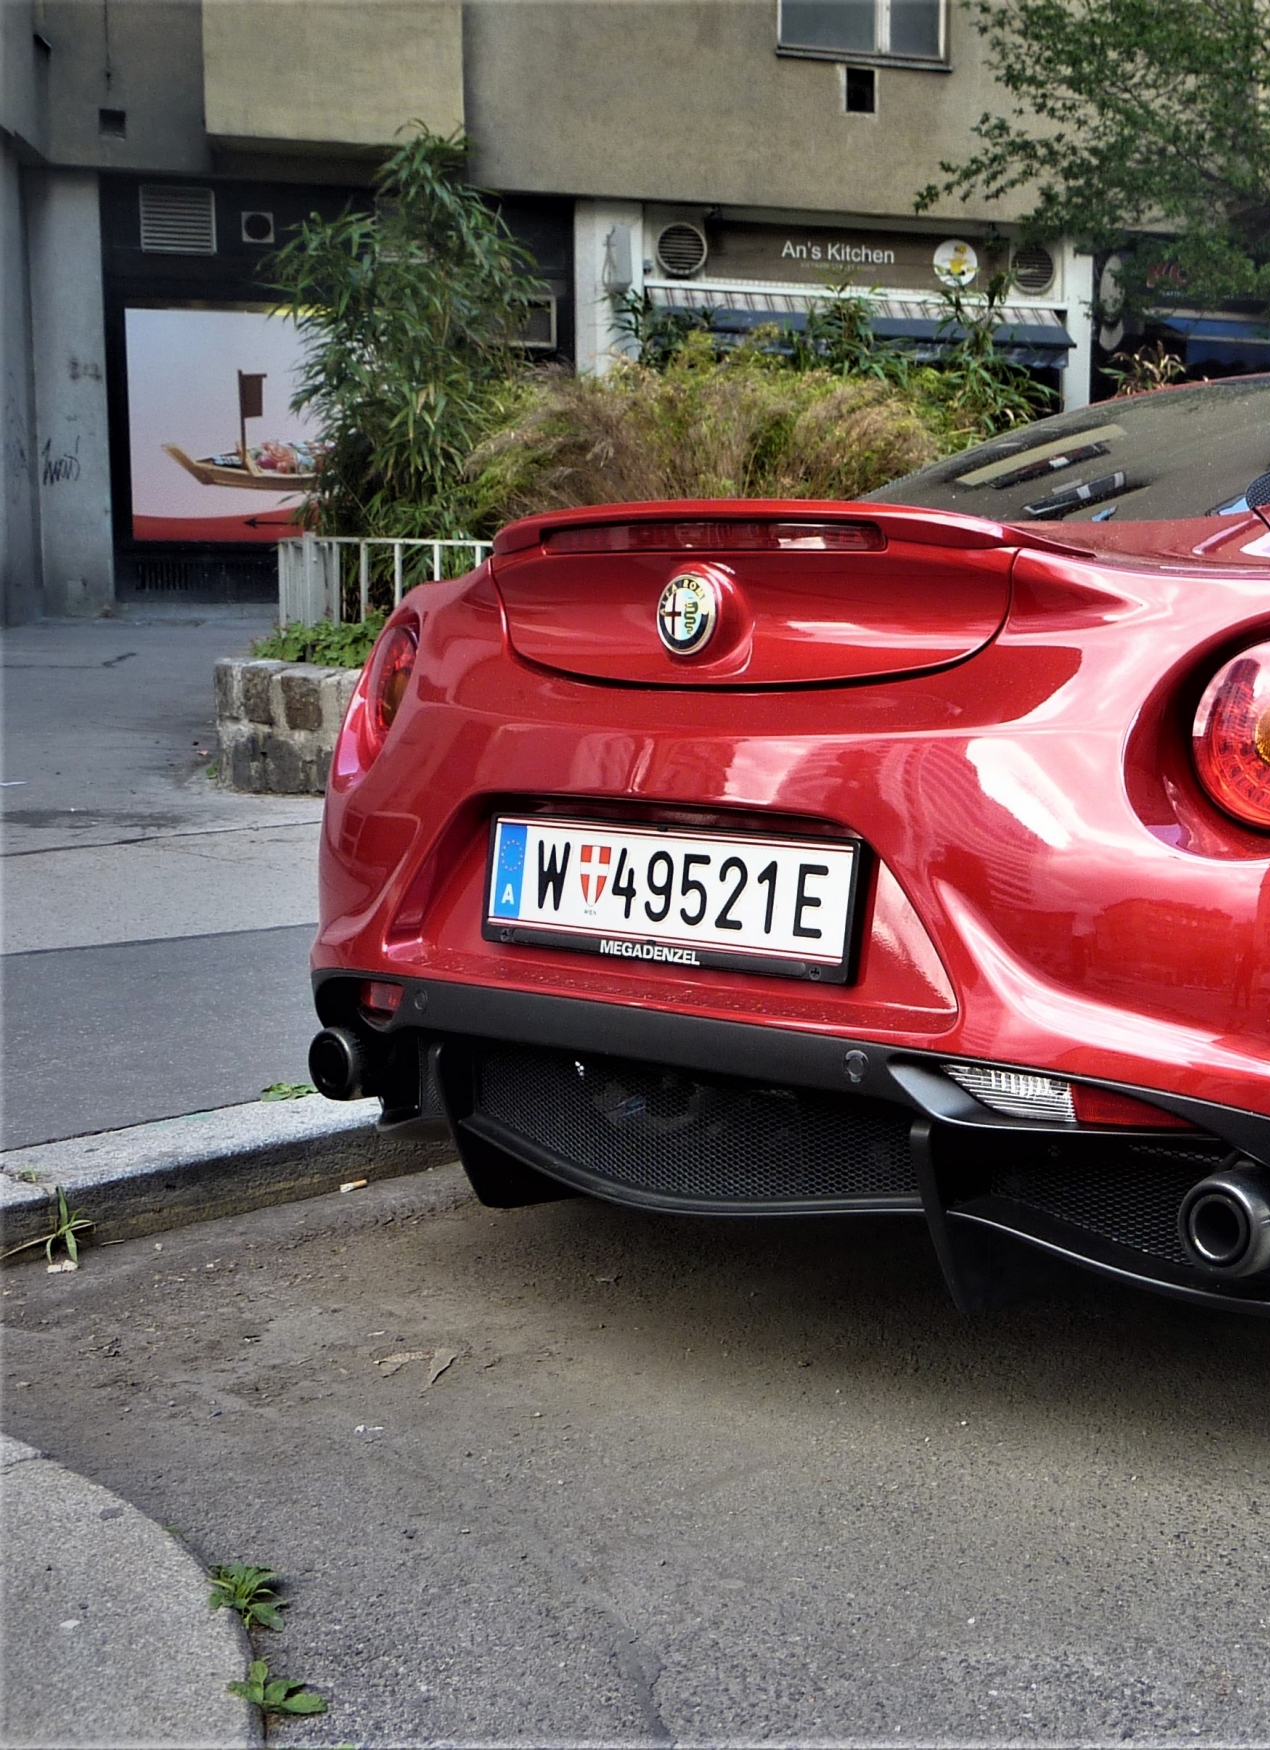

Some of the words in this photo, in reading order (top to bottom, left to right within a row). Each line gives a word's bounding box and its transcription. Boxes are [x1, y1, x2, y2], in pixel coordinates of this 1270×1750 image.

[781, 240, 822, 260] An's
[827, 243, 895, 264] Kitchen
[538, 838, 571, 911] W
[501, 883, 515, 905] A
[600, 939, 701, 966] MEGADENZEL
